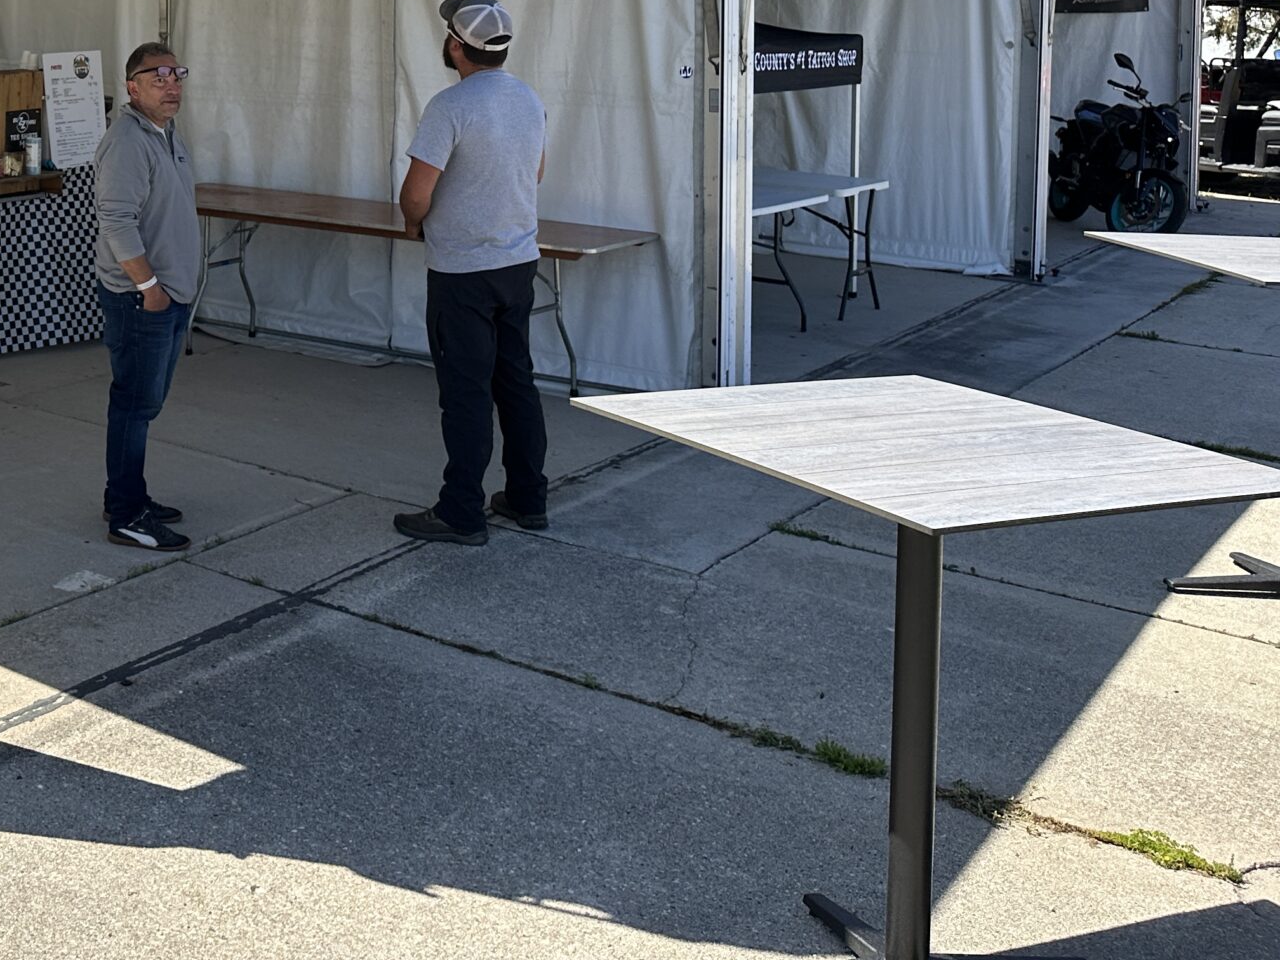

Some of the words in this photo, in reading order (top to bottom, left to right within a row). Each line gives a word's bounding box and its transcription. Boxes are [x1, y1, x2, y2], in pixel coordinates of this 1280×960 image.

[796, 51, 806, 69] #1
[807, 50, 836, 69] TATTOO
[837, 48, 857, 67] SHOP
